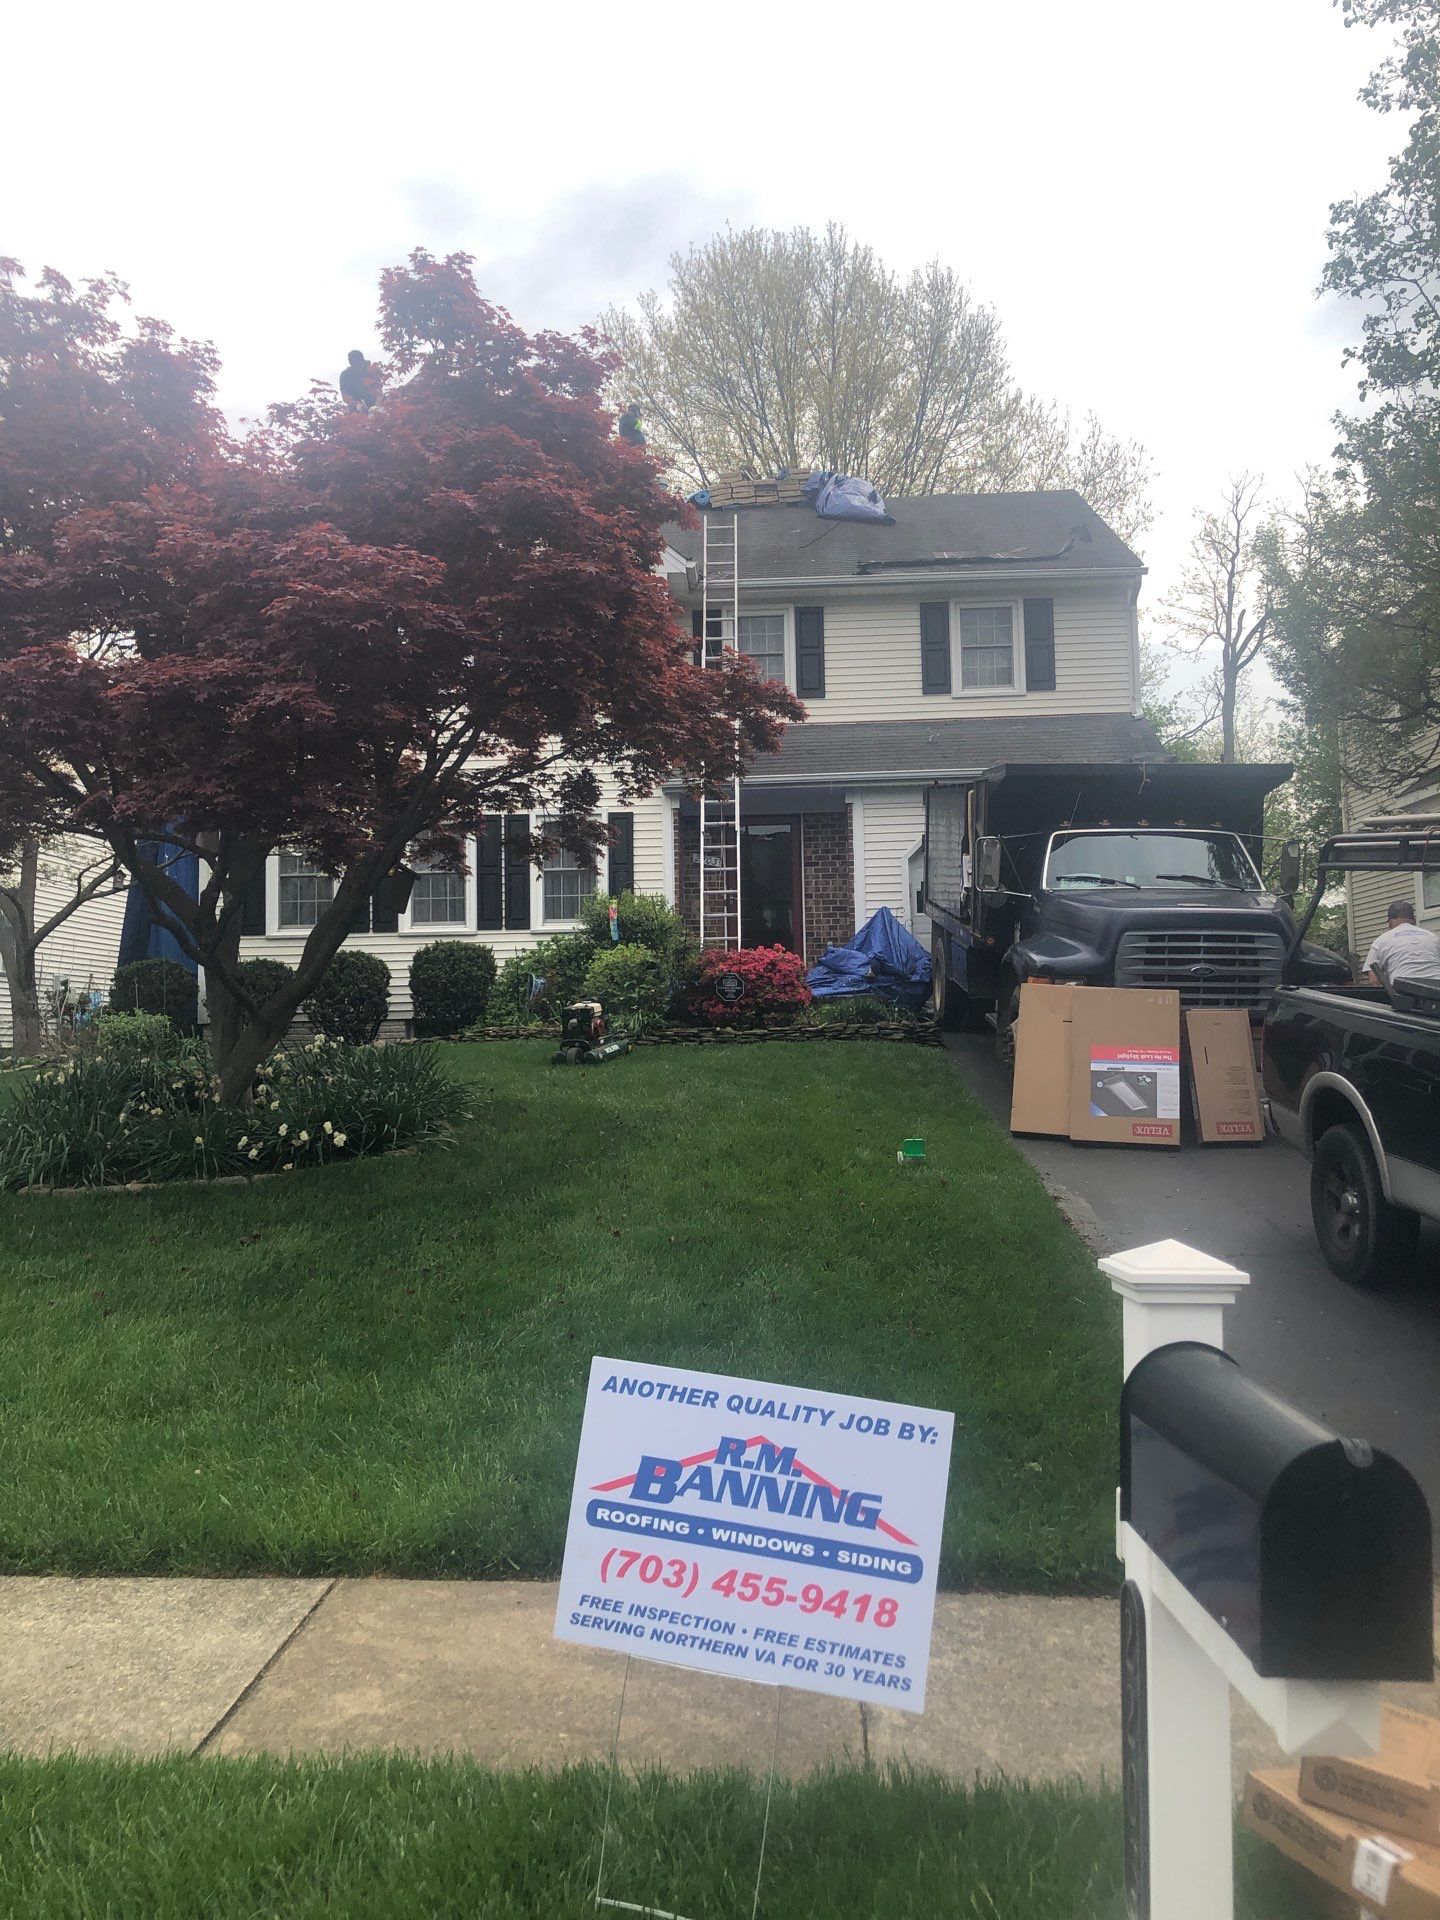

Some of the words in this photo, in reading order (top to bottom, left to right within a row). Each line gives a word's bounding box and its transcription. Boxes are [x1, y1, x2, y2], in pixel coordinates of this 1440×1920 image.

[1135, 1125, 1170, 1136] VELUX
[1219, 1124, 1253, 1134] VELUX
[601, 1375, 720, 1409] ANOTHER
[726, 1394, 836, 1427] QUALITY
[838, 1413, 892, 1437] JOB
[897, 1422, 939, 1445] BY:
[713, 1435, 803, 1478] R.M.
[629, 1455, 883, 1531] BANNING
[596, 1507, 690, 1535] ROOFING
[711, 1527, 815, 1557] WINDOWS
[836, 1549, 912, 1575] SIDING
[600, 1548, 699, 1599] (703)
[711, 1568, 899, 1629] 455-9418
[570, 1611, 646, 1638] SERVING
[649, 1628, 750, 1659] NORTHERN
[754, 1648, 777, 1665] VA
[781, 1653, 820, 1673] FOR
[823, 1661, 847, 1678] 30
[852, 1667, 913, 1692] YEARS
[578, 1594, 625, 1614] FREE
[627, 1603, 737, 1635] INSPECTION
[752, 1627, 801, 1648] FREE
[803, 1636, 907, 1669] ESTIMATES
